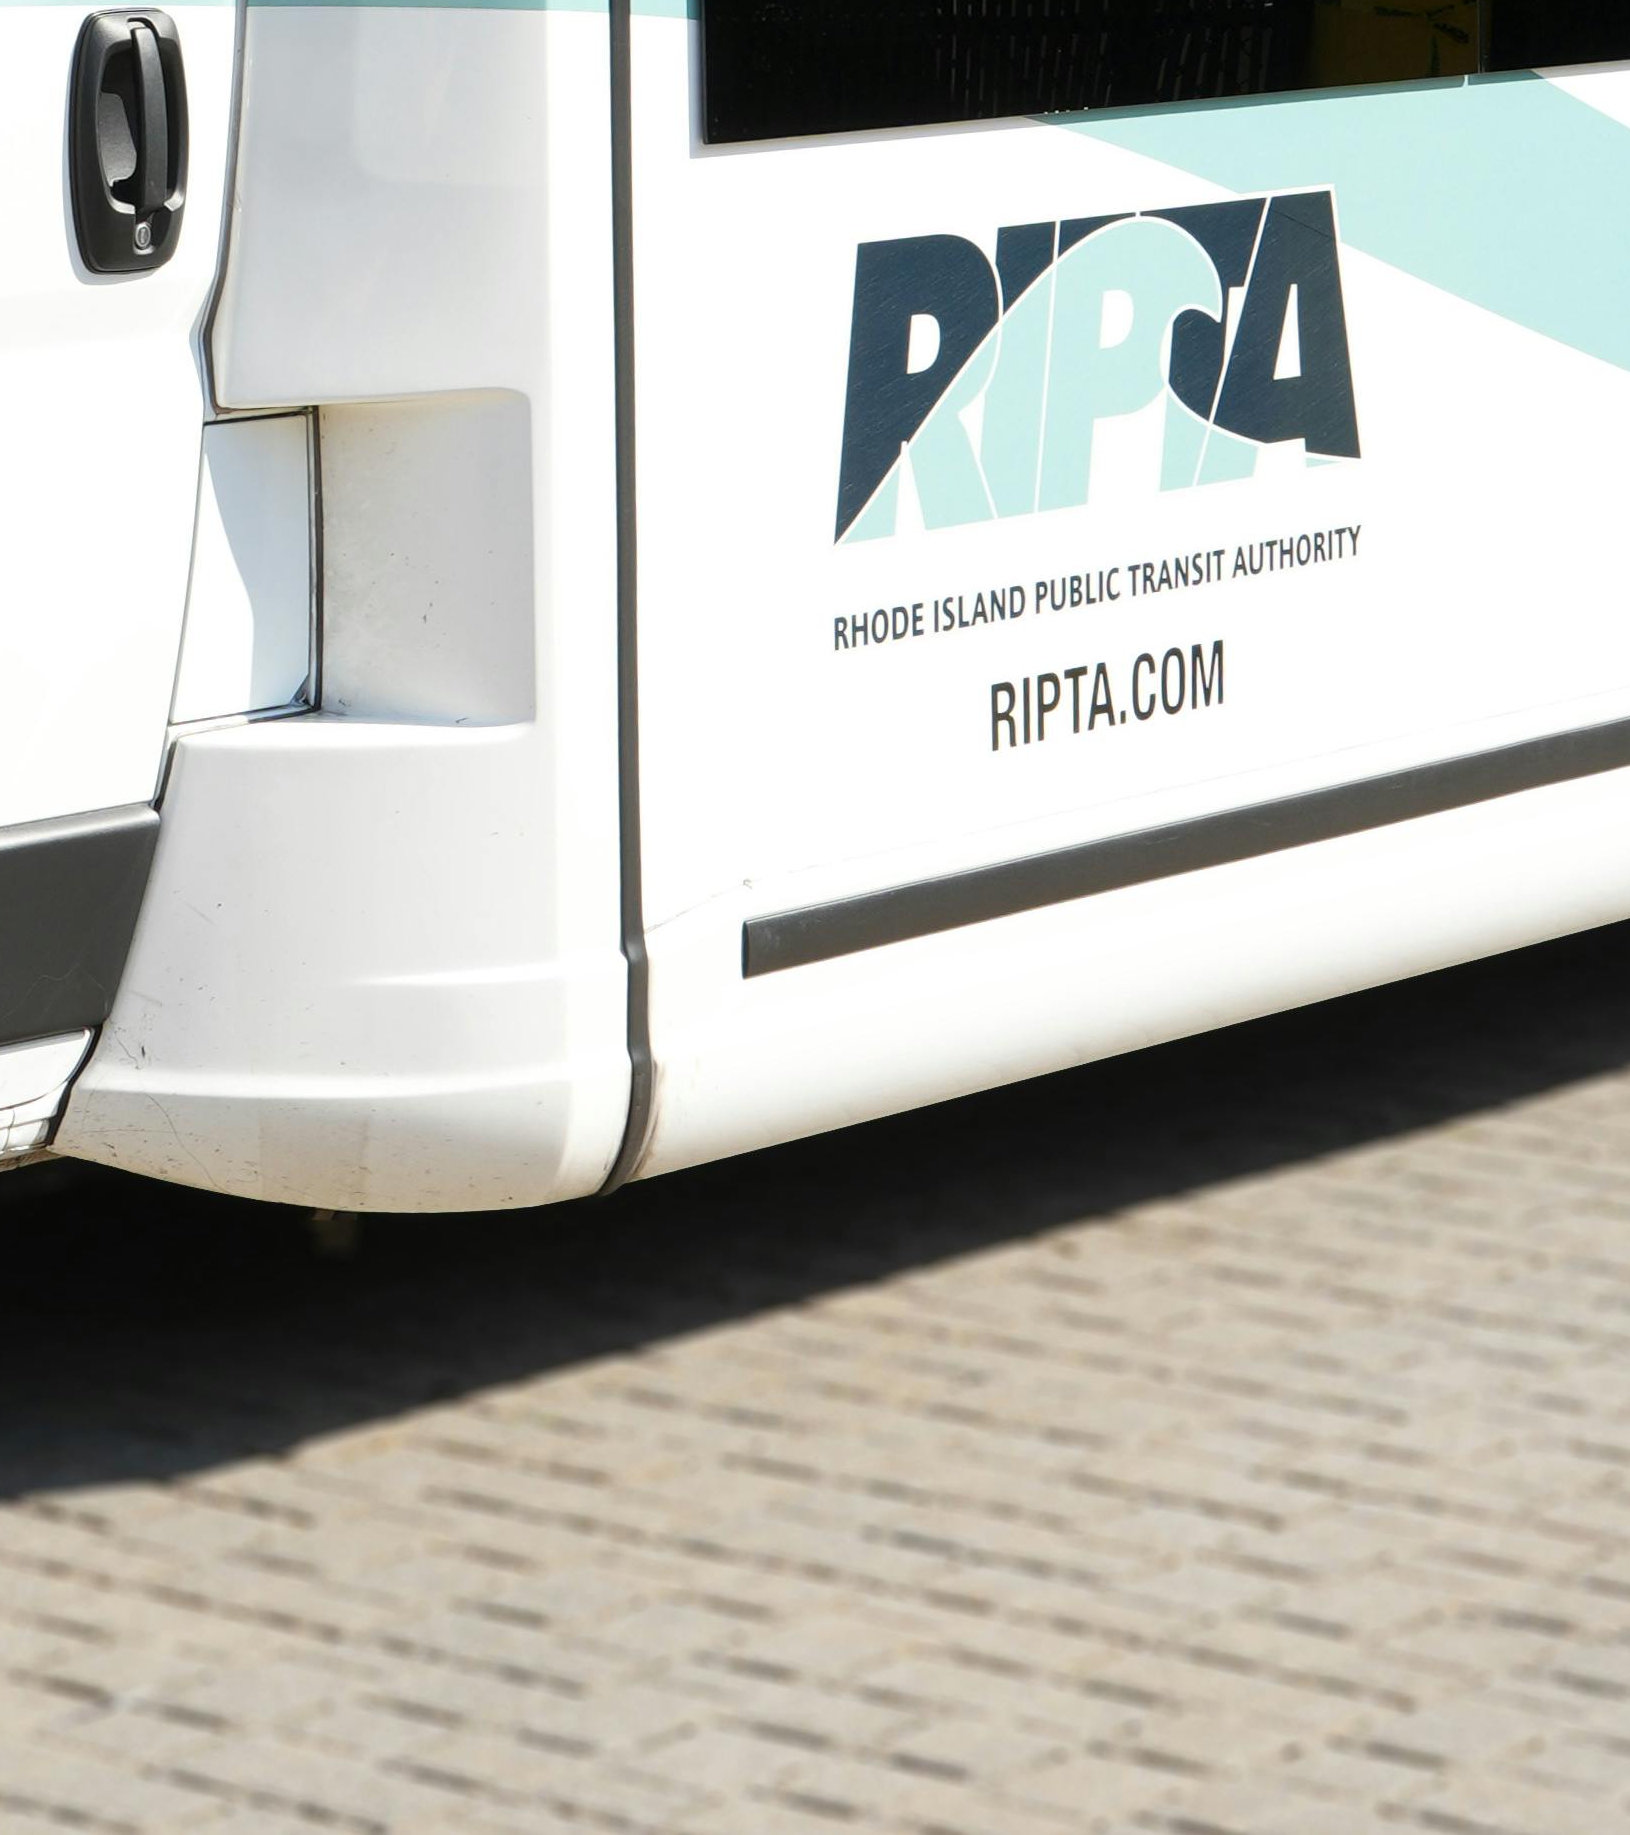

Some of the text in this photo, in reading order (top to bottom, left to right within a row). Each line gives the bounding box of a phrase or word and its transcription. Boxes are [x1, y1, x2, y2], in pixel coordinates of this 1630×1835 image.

[834, 190, 1362, 546] RIPTA
[834, 525, 1362, 651] RHODE ISLAND PUBLIC TRANSIT AUTHORITY
[991, 640, 1224, 751] RIPTA.COM
